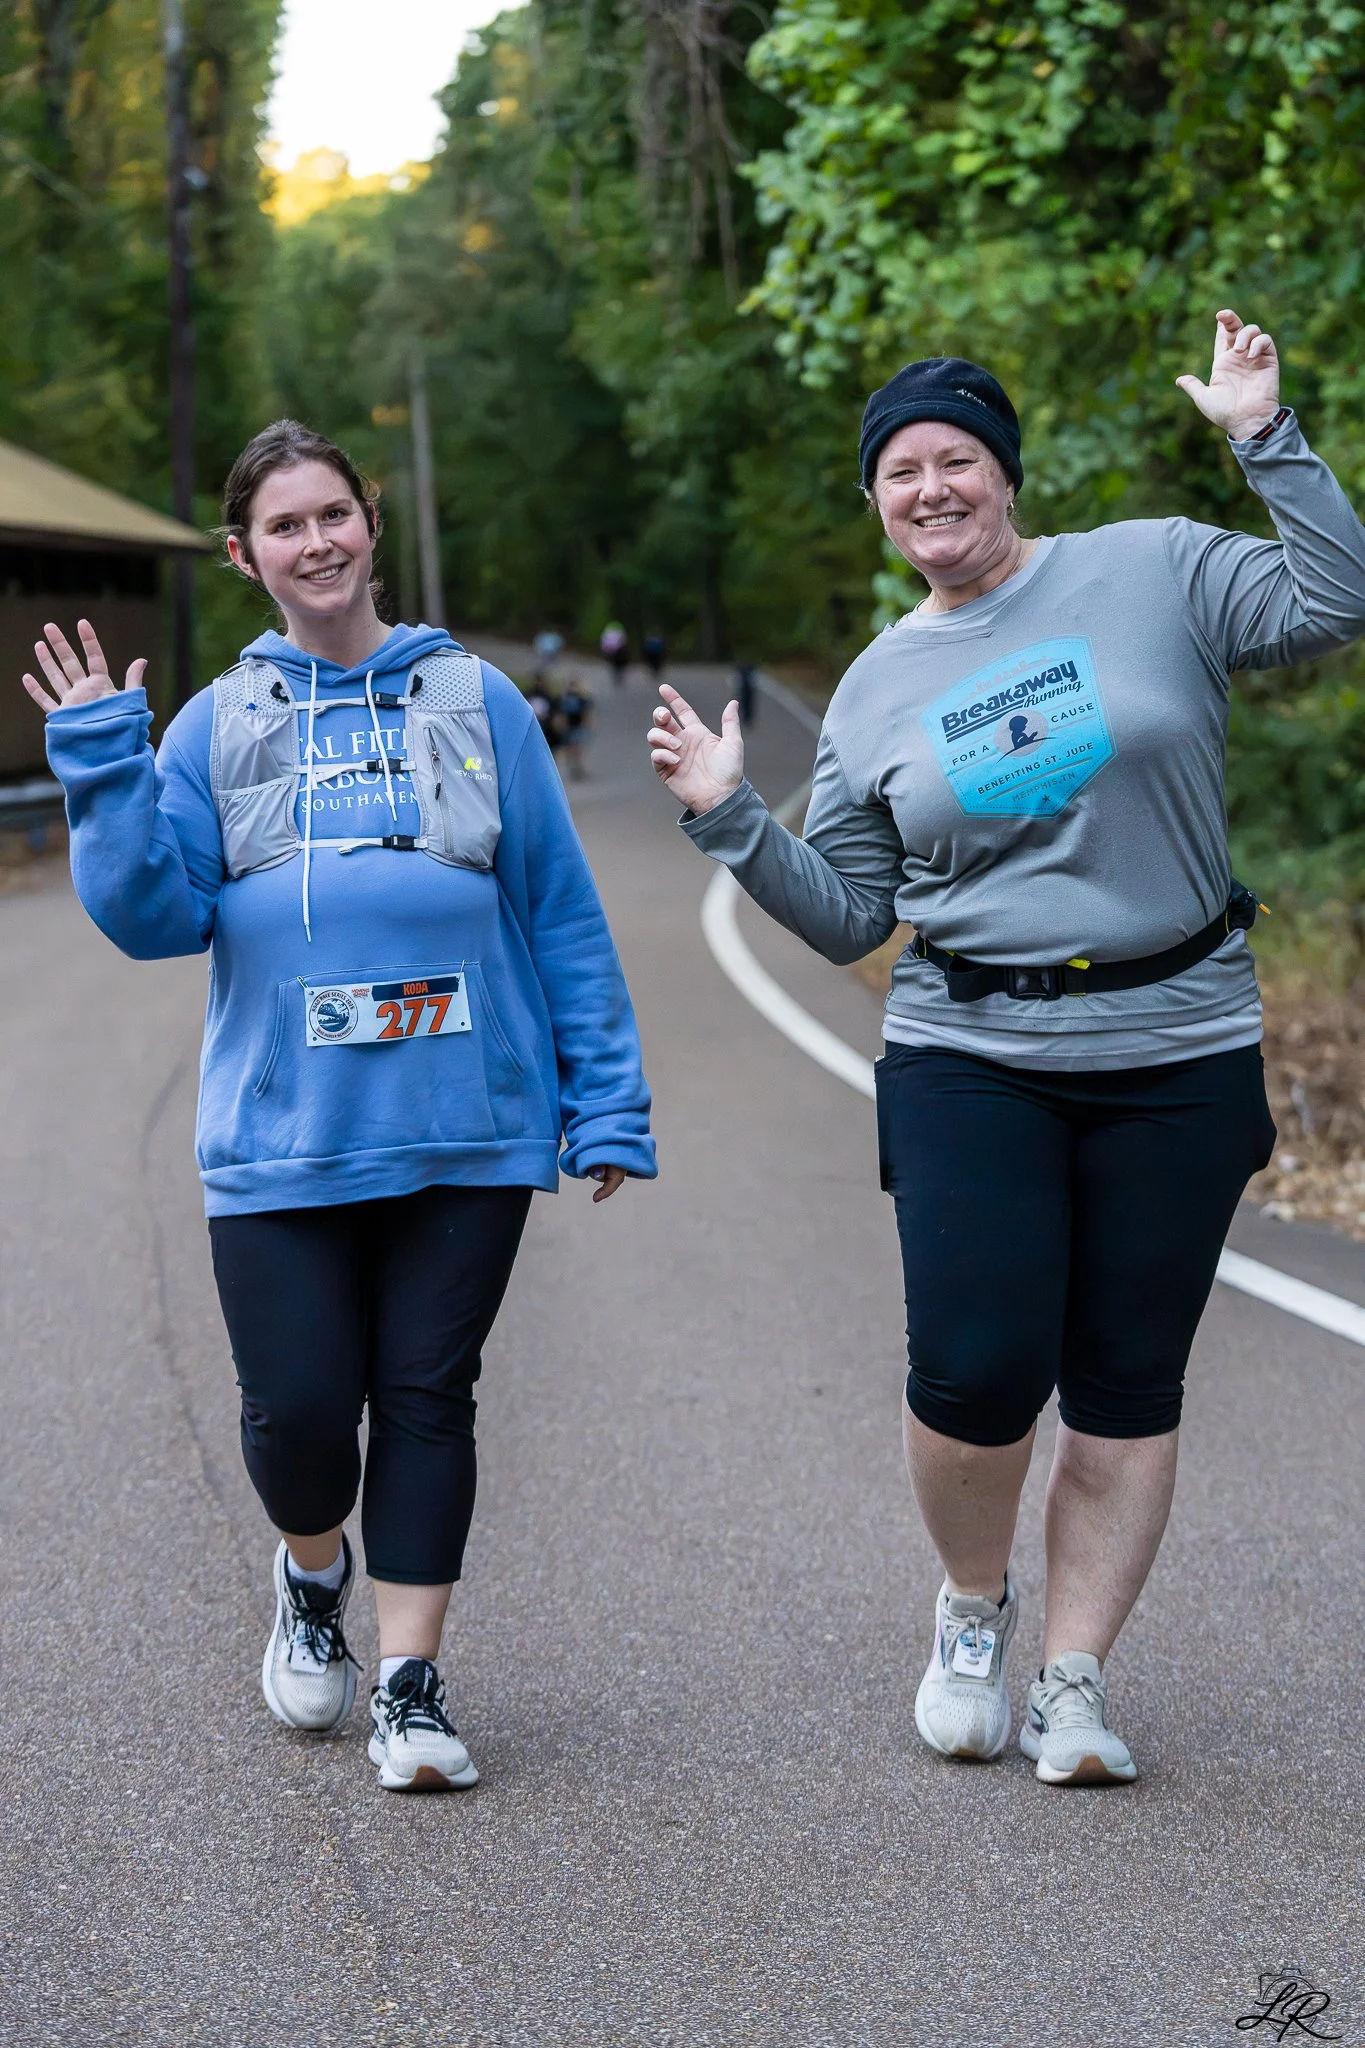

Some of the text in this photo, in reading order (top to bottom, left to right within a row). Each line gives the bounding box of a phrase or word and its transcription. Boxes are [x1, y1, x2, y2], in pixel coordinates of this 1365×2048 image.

[941, 660, 1078, 733] Breakaway
[1024, 680, 1084, 708] Running
[952, 702, 1095, 766] FOR A CAUSE
[977, 742, 1094, 795] BENEFITING ST. JUDE
[403, 981, 429, 996] KODA
[376, 994, 453, 1040] 277
